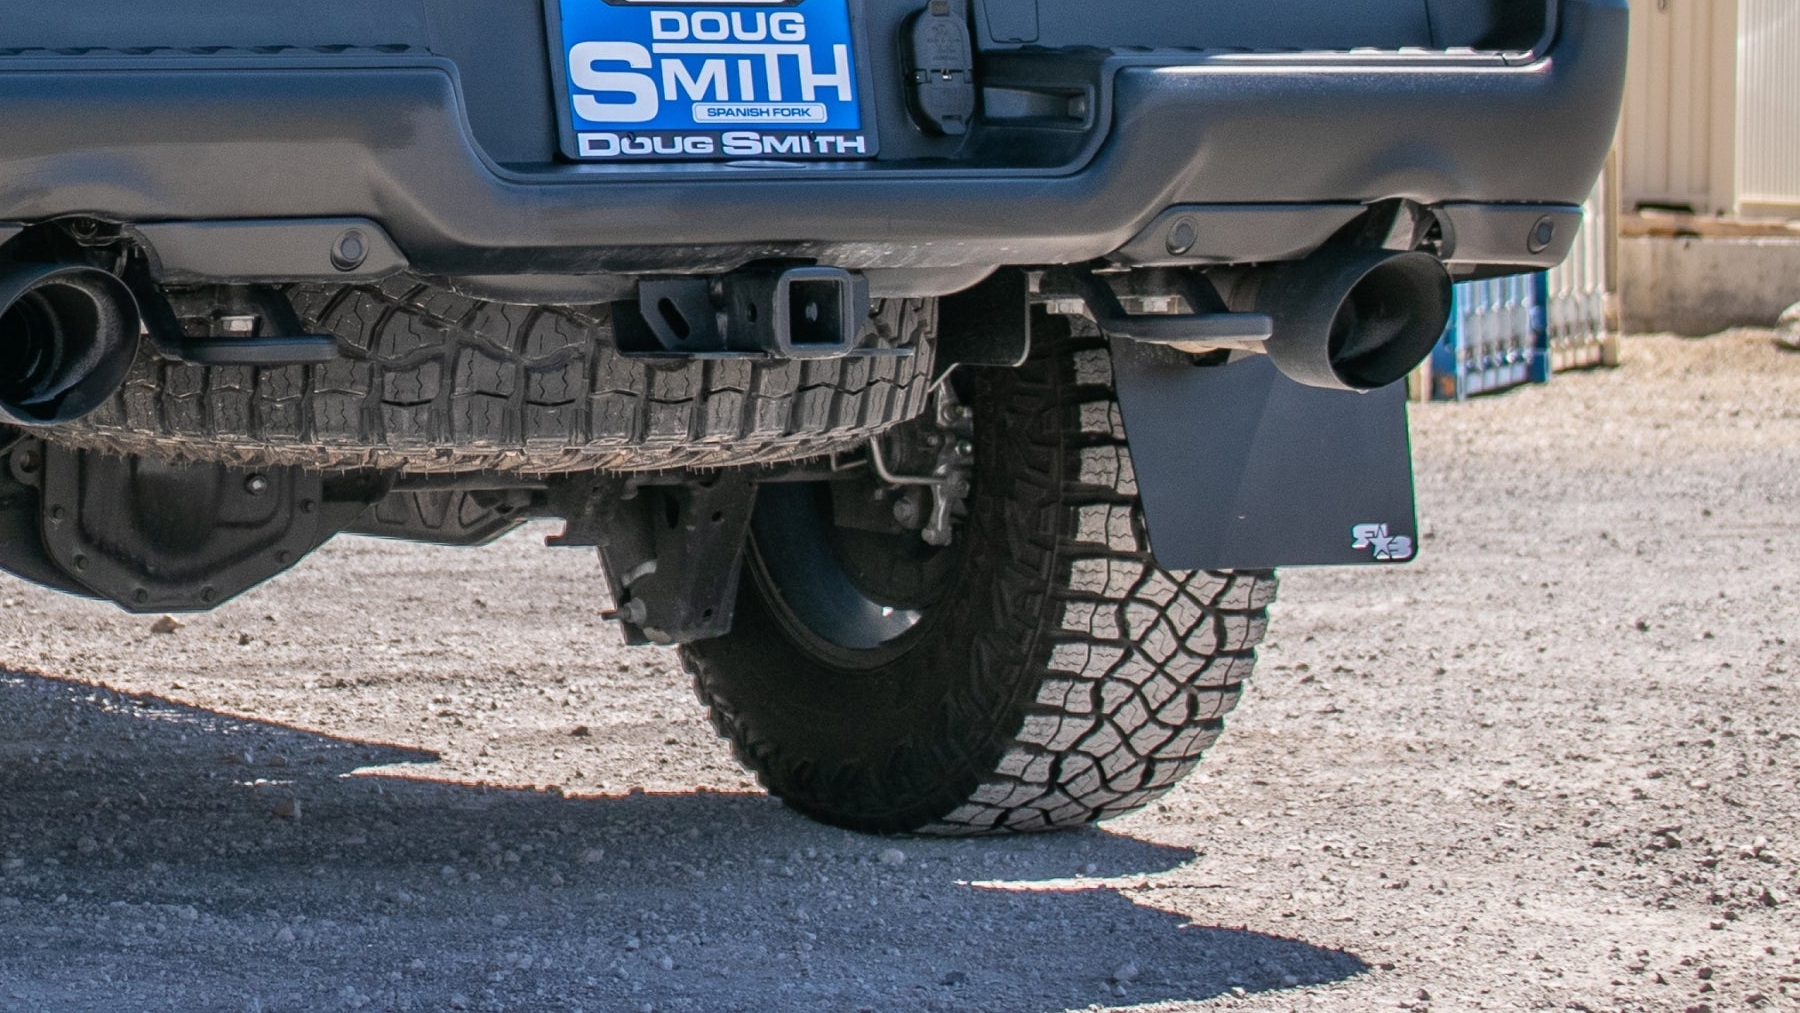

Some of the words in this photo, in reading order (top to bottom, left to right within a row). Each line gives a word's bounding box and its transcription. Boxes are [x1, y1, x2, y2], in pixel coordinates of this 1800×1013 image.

[650, 10, 806, 41] DOUG
[568, 40, 852, 123] SMITH
[706, 107, 771, 118] SPANISH
[773, 107, 812, 118] FORK
